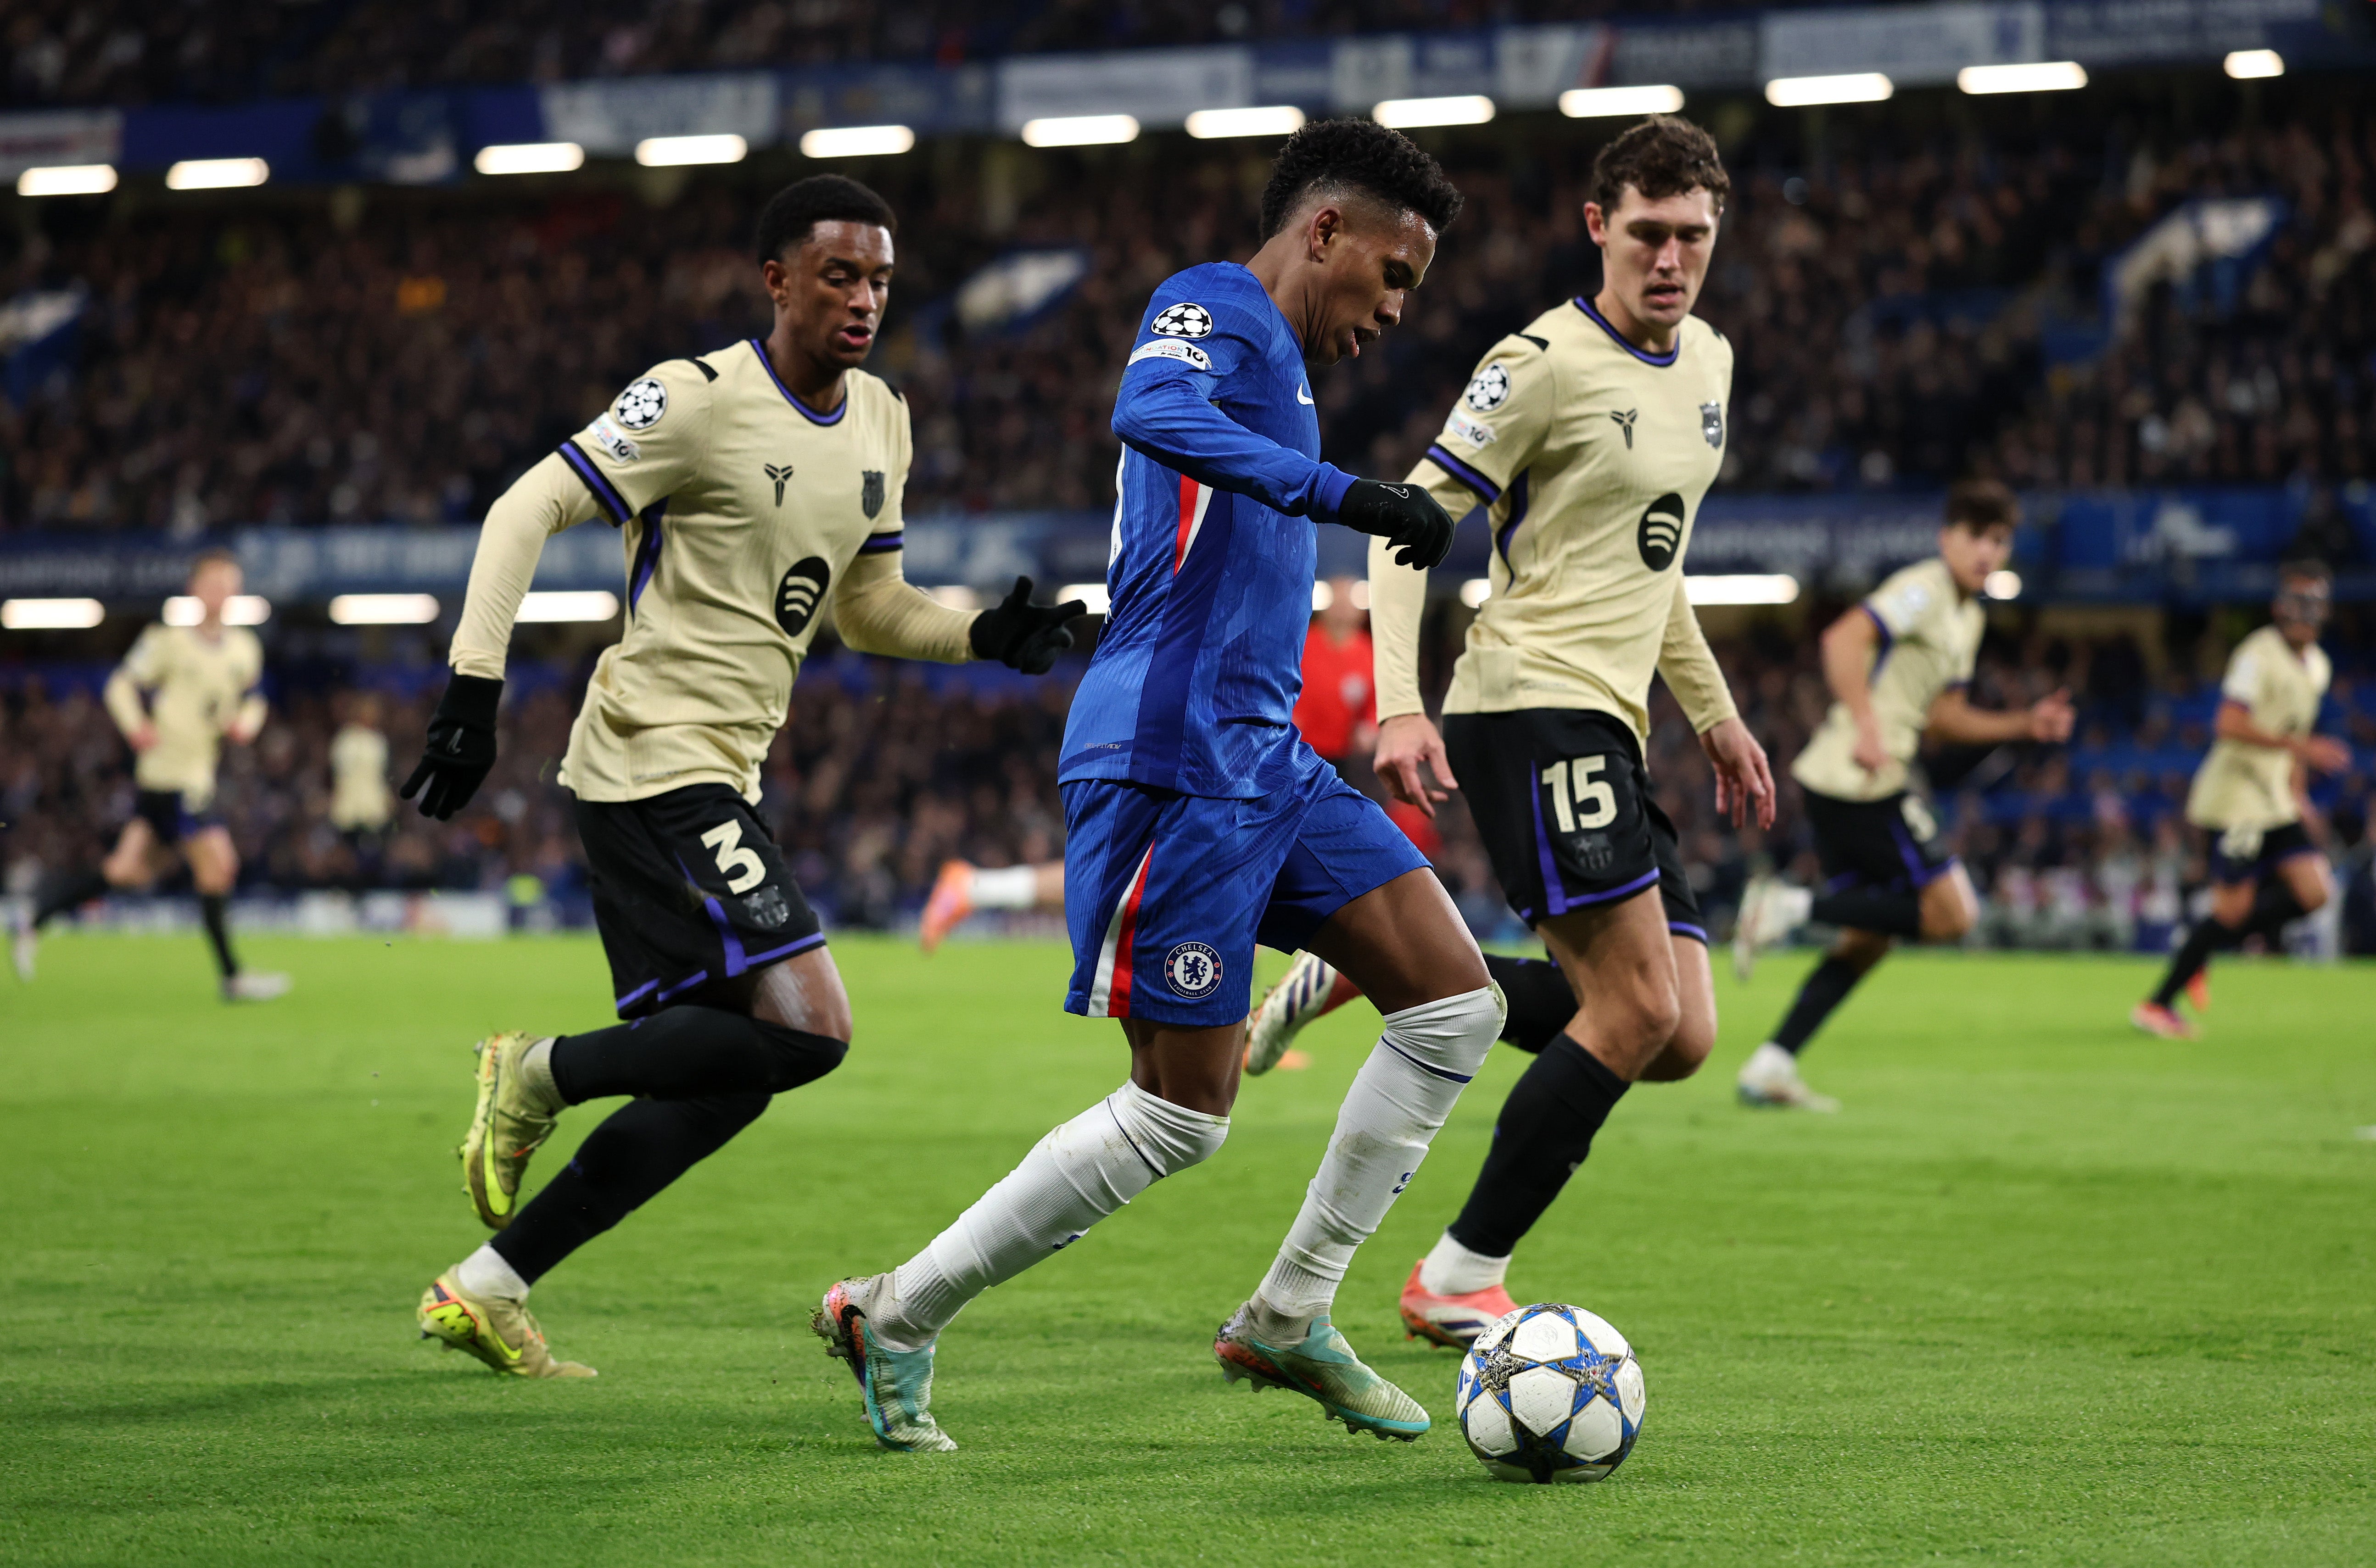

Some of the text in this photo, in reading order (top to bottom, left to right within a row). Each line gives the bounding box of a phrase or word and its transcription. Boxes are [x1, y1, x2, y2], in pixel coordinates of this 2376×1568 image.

[1131, 345, 1183, 359] UNDATION
[1185, 346, 1203, 362] 10
[1542, 754, 1618, 833] 15
[700, 819, 766, 895] 3
[1175, 944, 1213, 957] CHELSEA
[1174, 984, 1212, 996] FOOTBALL CLUB
